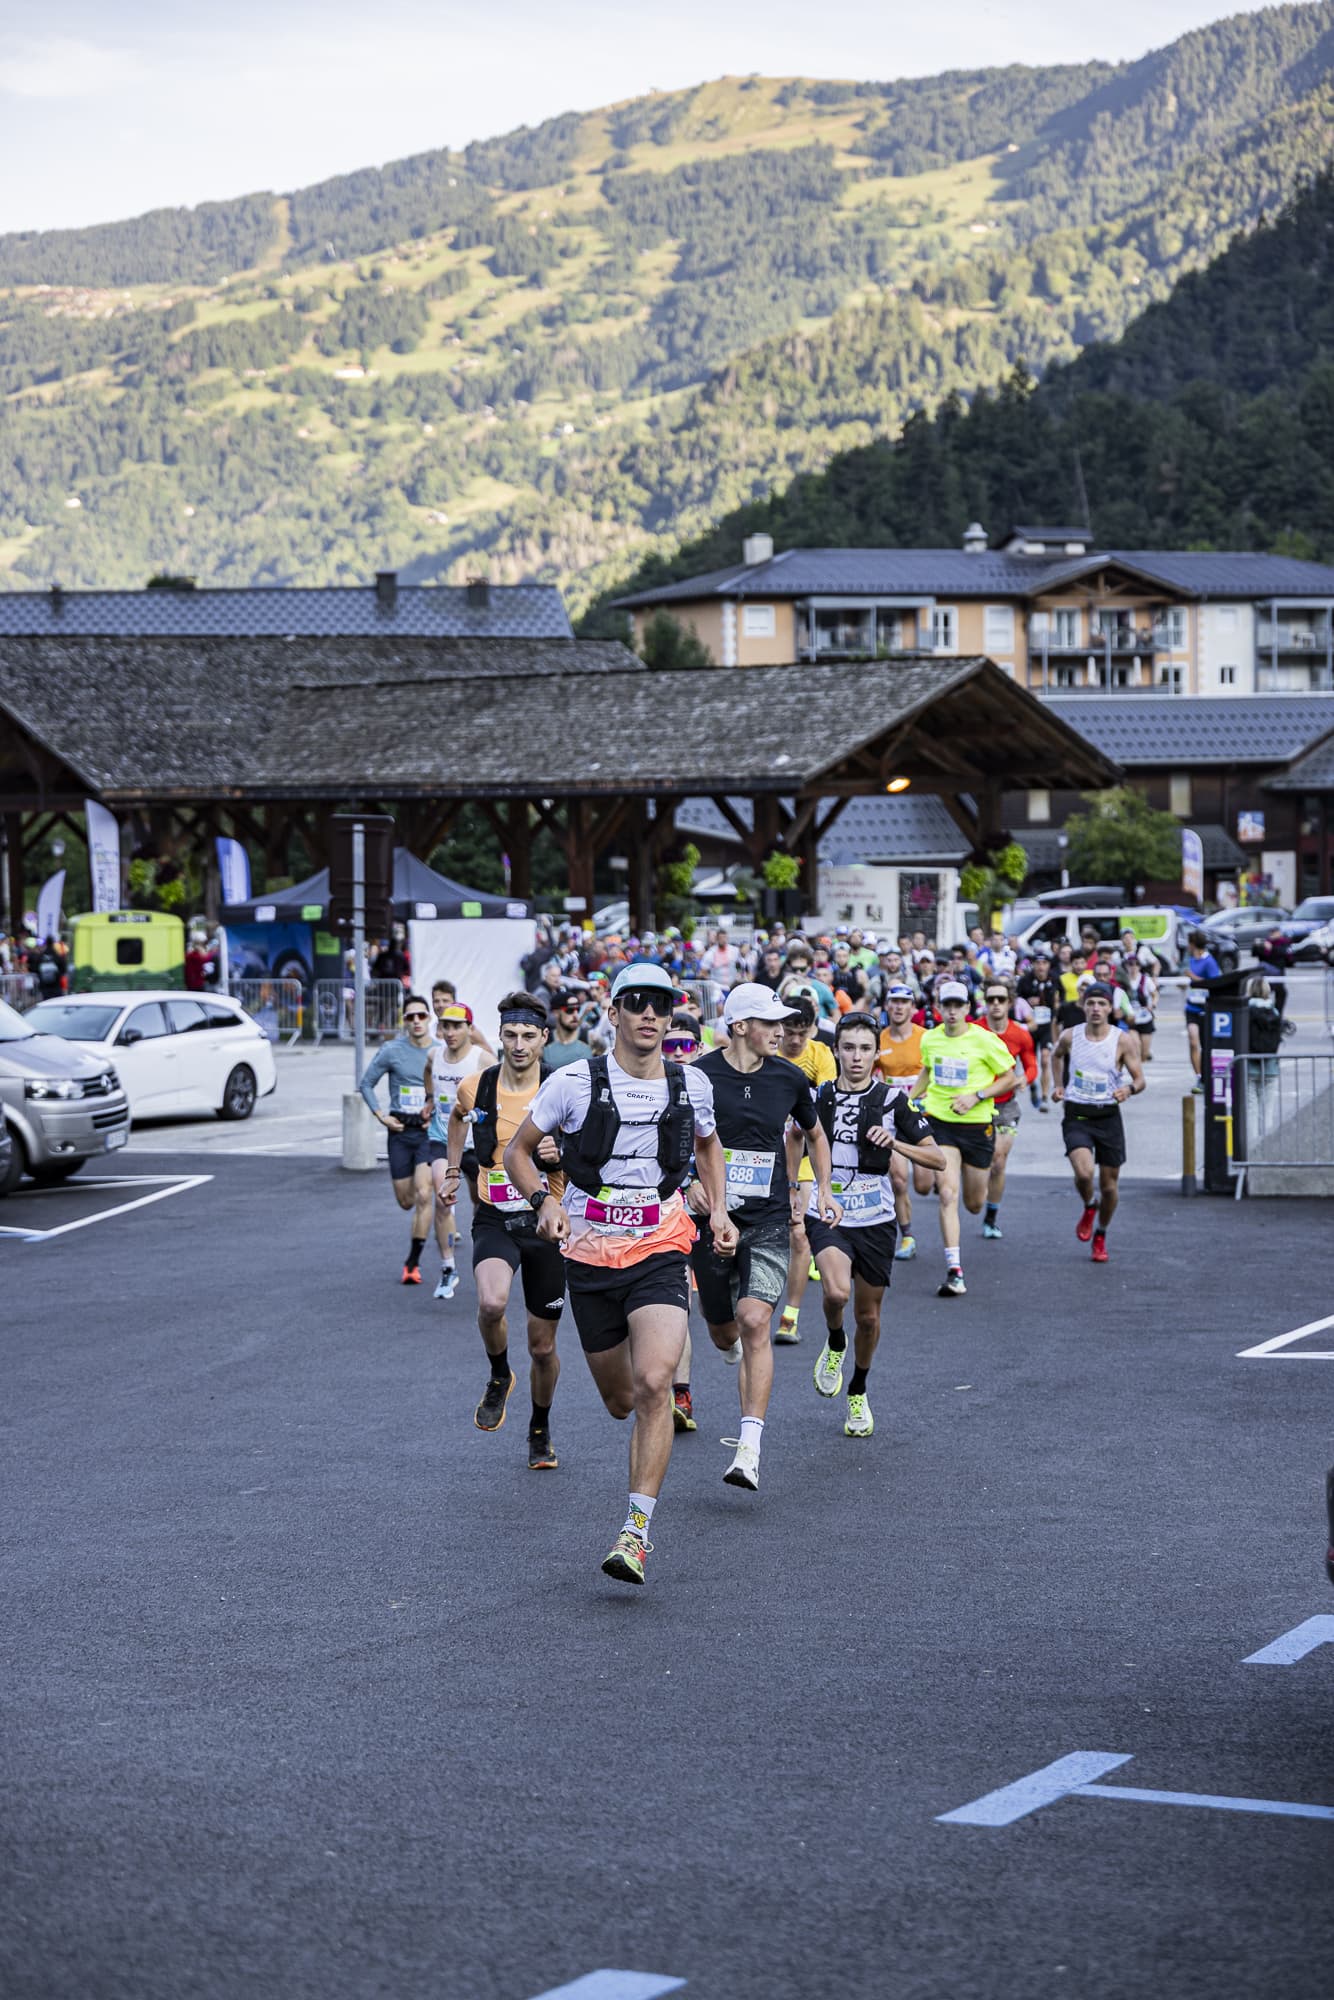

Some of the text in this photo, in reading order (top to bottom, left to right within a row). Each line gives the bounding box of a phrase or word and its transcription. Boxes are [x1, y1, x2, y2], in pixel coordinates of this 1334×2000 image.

[1215, 1013, 1230, 1033] P
[626, 1092, 650, 1100] CRAFT
[679, 1118, 691, 1164] IPRUN
[729, 1166, 754, 1183] 688
[845, 1195, 866, 1209] 704
[603, 1206, 643, 1225] 1023
